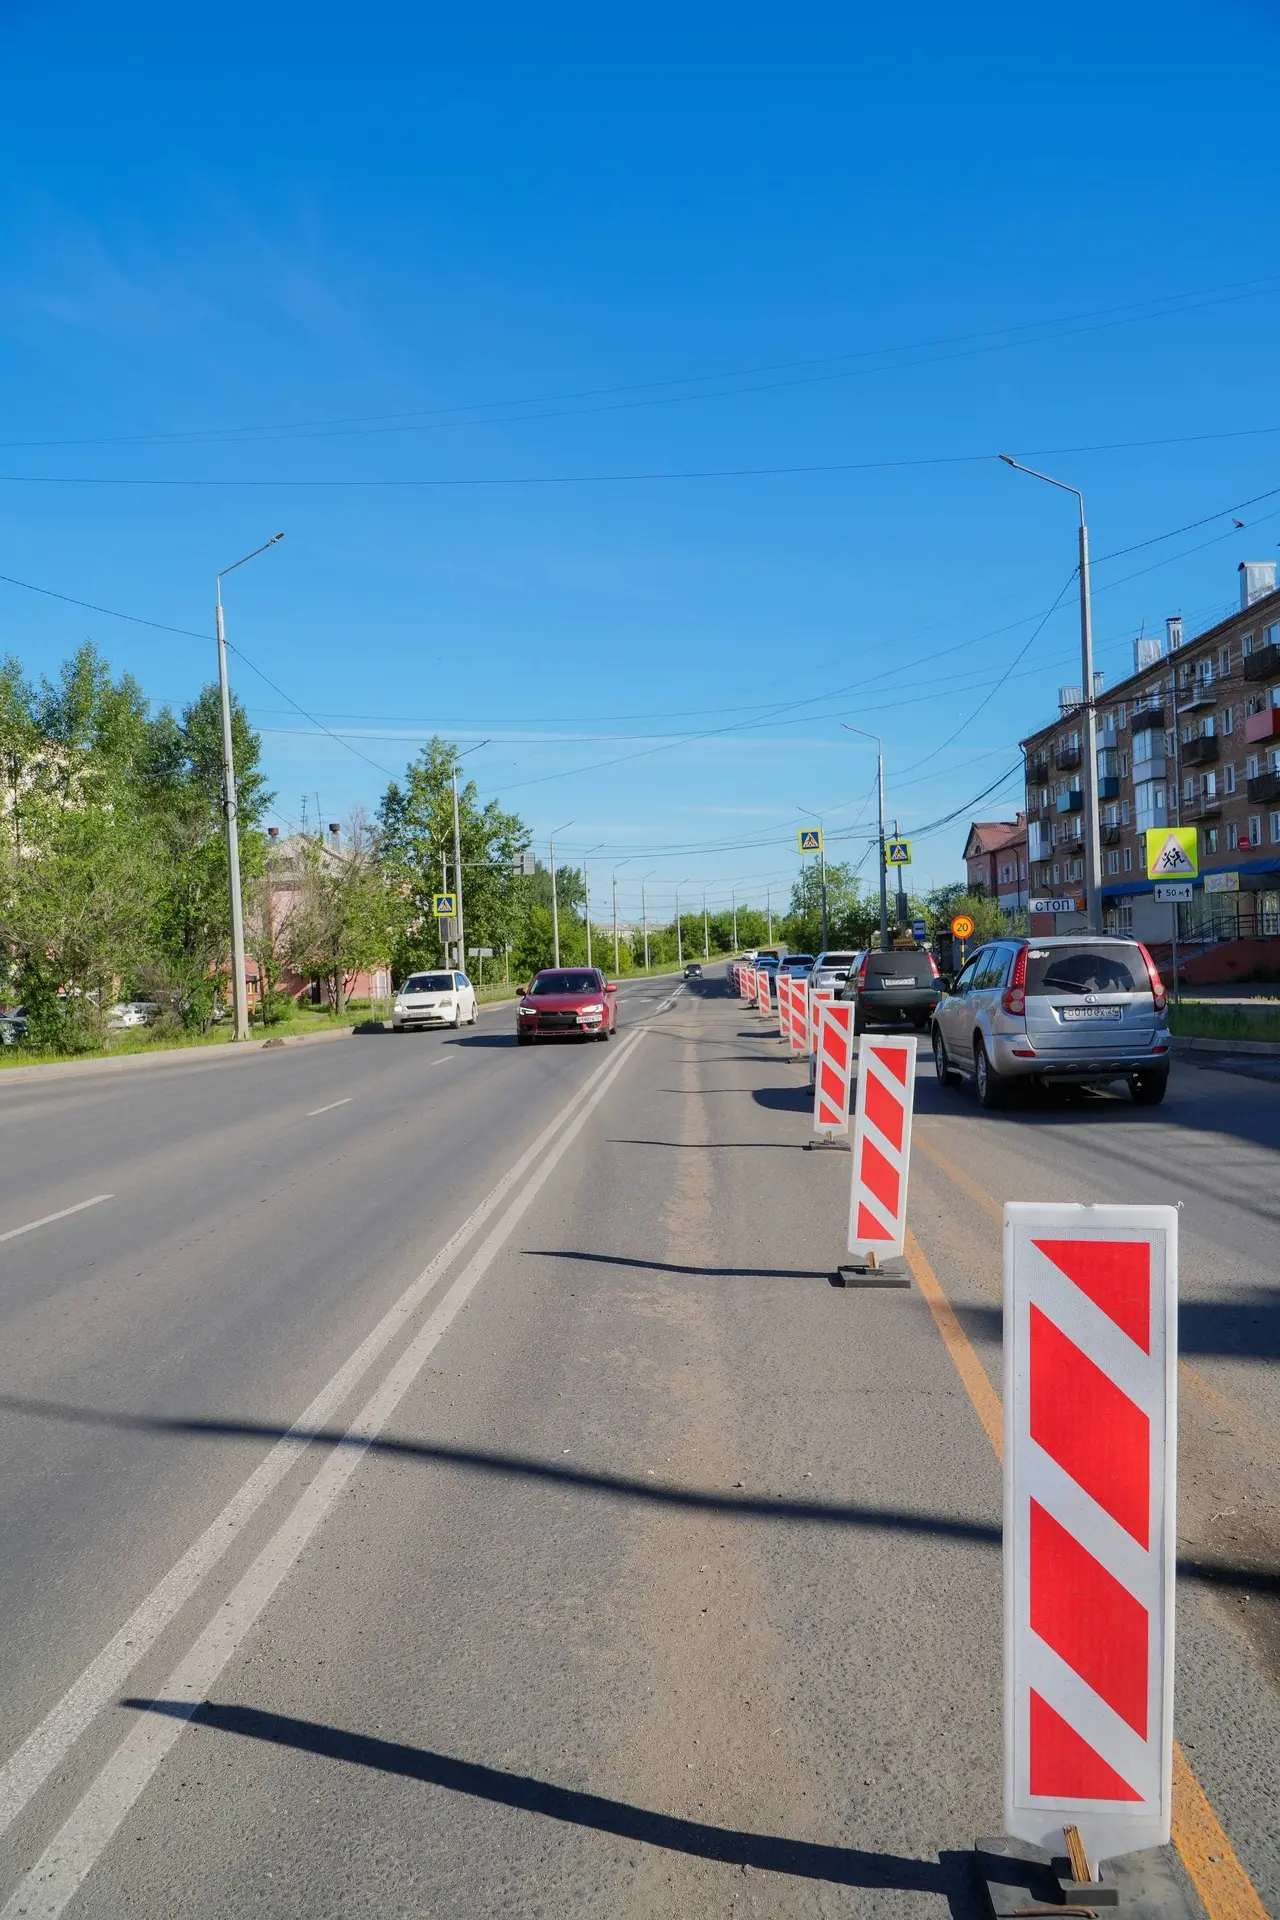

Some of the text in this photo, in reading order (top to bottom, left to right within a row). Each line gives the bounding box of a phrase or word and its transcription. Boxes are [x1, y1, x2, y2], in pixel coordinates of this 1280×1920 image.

[1165, 888, 1177, 897] 50
[1035, 900, 1070, 912] СТОП
[956, 922, 969, 932] 20
